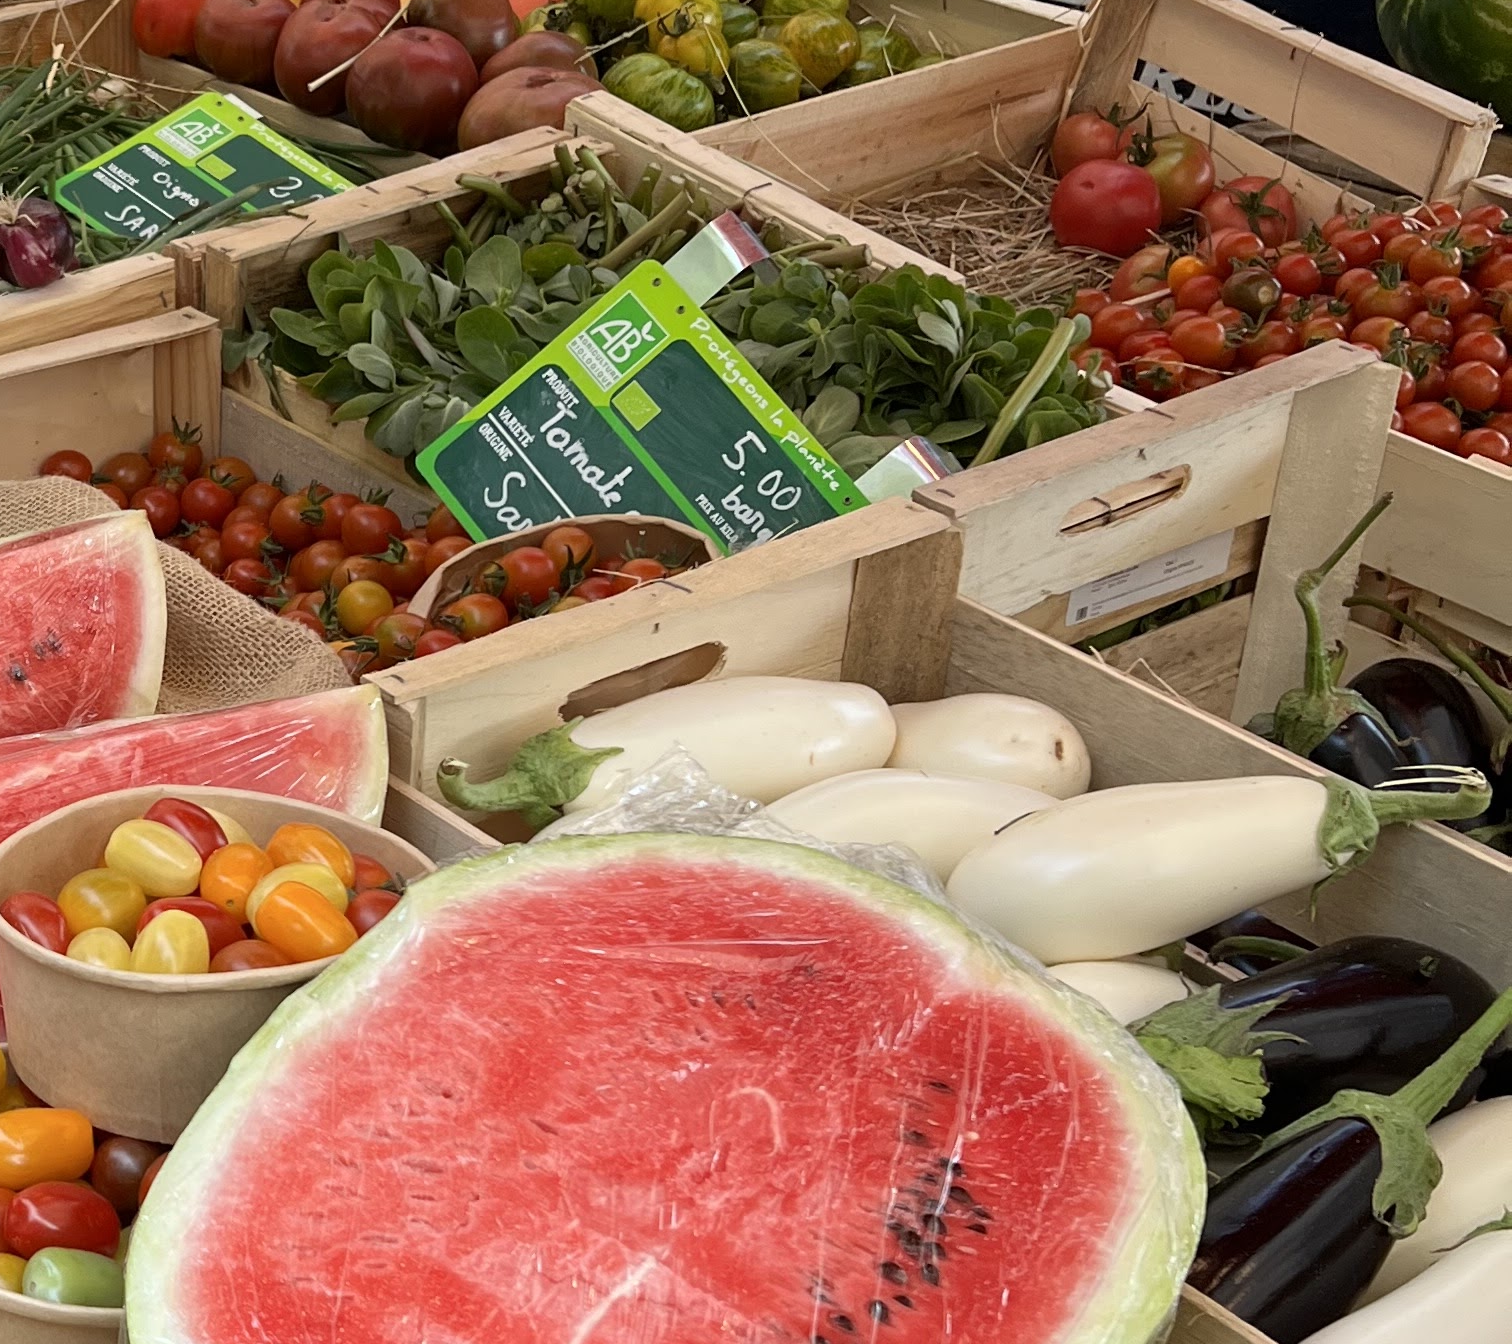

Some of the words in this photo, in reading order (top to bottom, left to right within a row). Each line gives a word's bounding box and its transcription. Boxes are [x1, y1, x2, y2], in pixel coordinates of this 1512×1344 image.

[172, 120, 215, 145] AB
[577, 334, 620, 382] AGRICULTURE
[590, 319, 643, 364] AB
[570, 341, 613, 388] BIOLOGIQUE
[690, 317, 768, 410] Protégeons
[769, 408, 784, 429] la
[541, 367, 580, 409] PRODUIT
[479, 422, 514, 462] ORIGINE
[497, 405, 536, 449] VARIÉTÉ
[539, 401, 633, 509] Tomate
[695, 493, 714, 517] PRIX
[709, 511, 725, 529] AU
